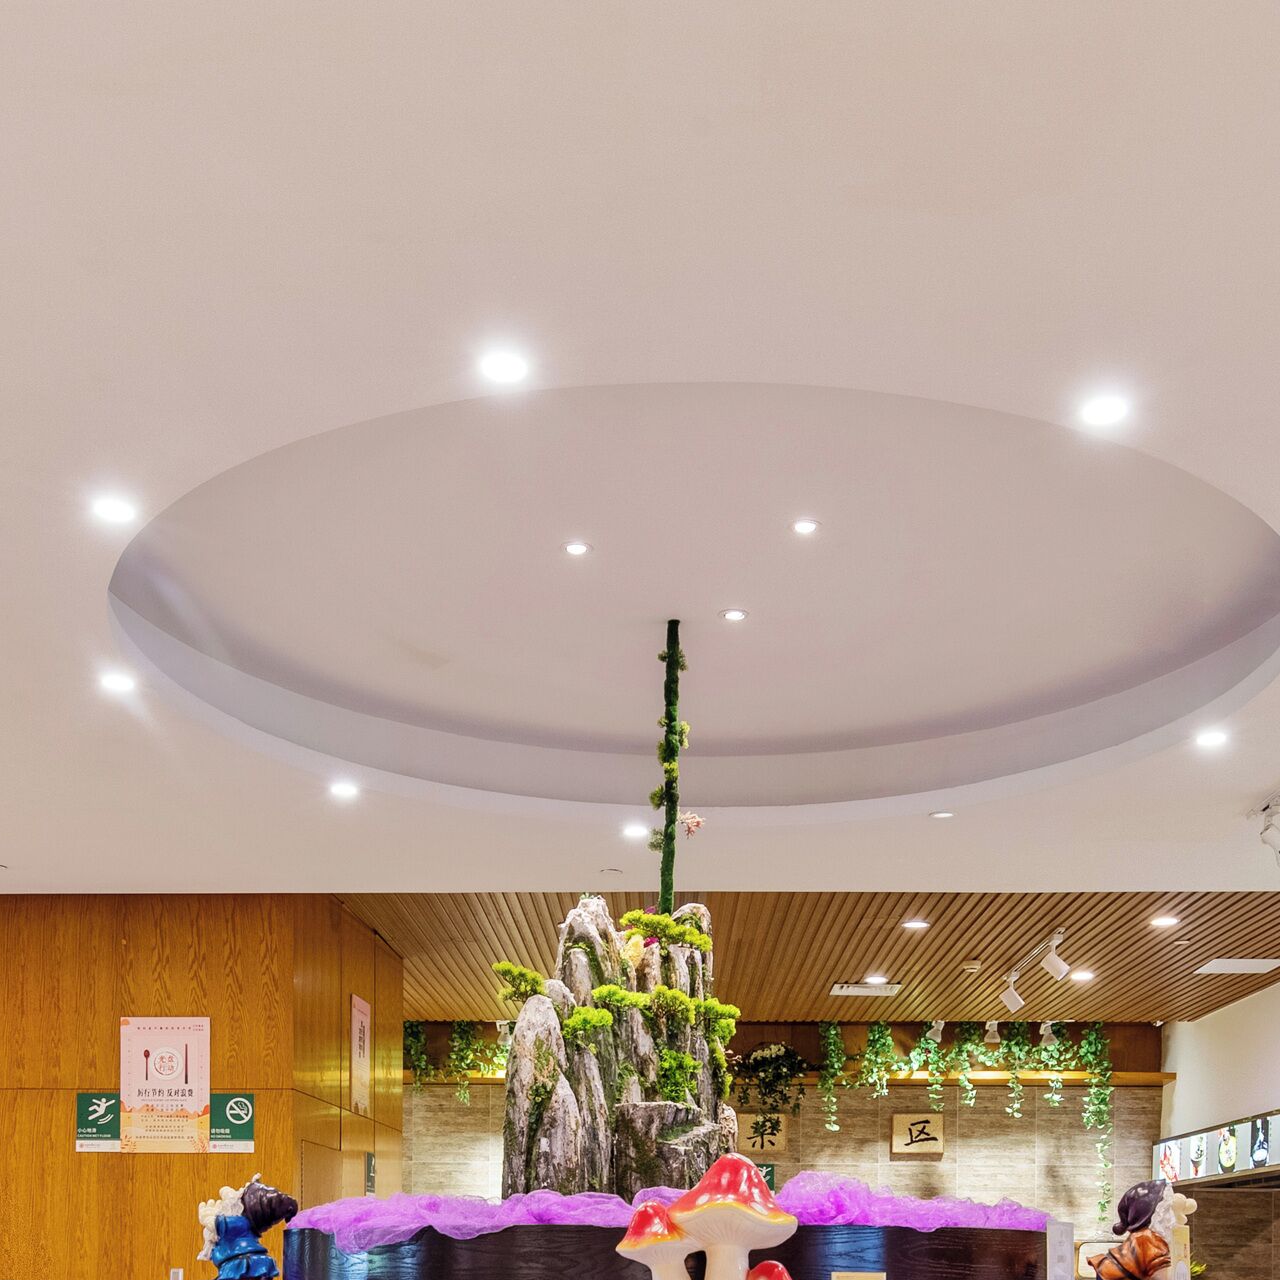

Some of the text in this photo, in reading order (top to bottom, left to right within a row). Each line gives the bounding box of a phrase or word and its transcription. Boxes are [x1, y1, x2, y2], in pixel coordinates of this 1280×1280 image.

[137, 1088, 193, 1097] 厉行节约 反对浪费
[904, 1119, 938, 1146] 区
